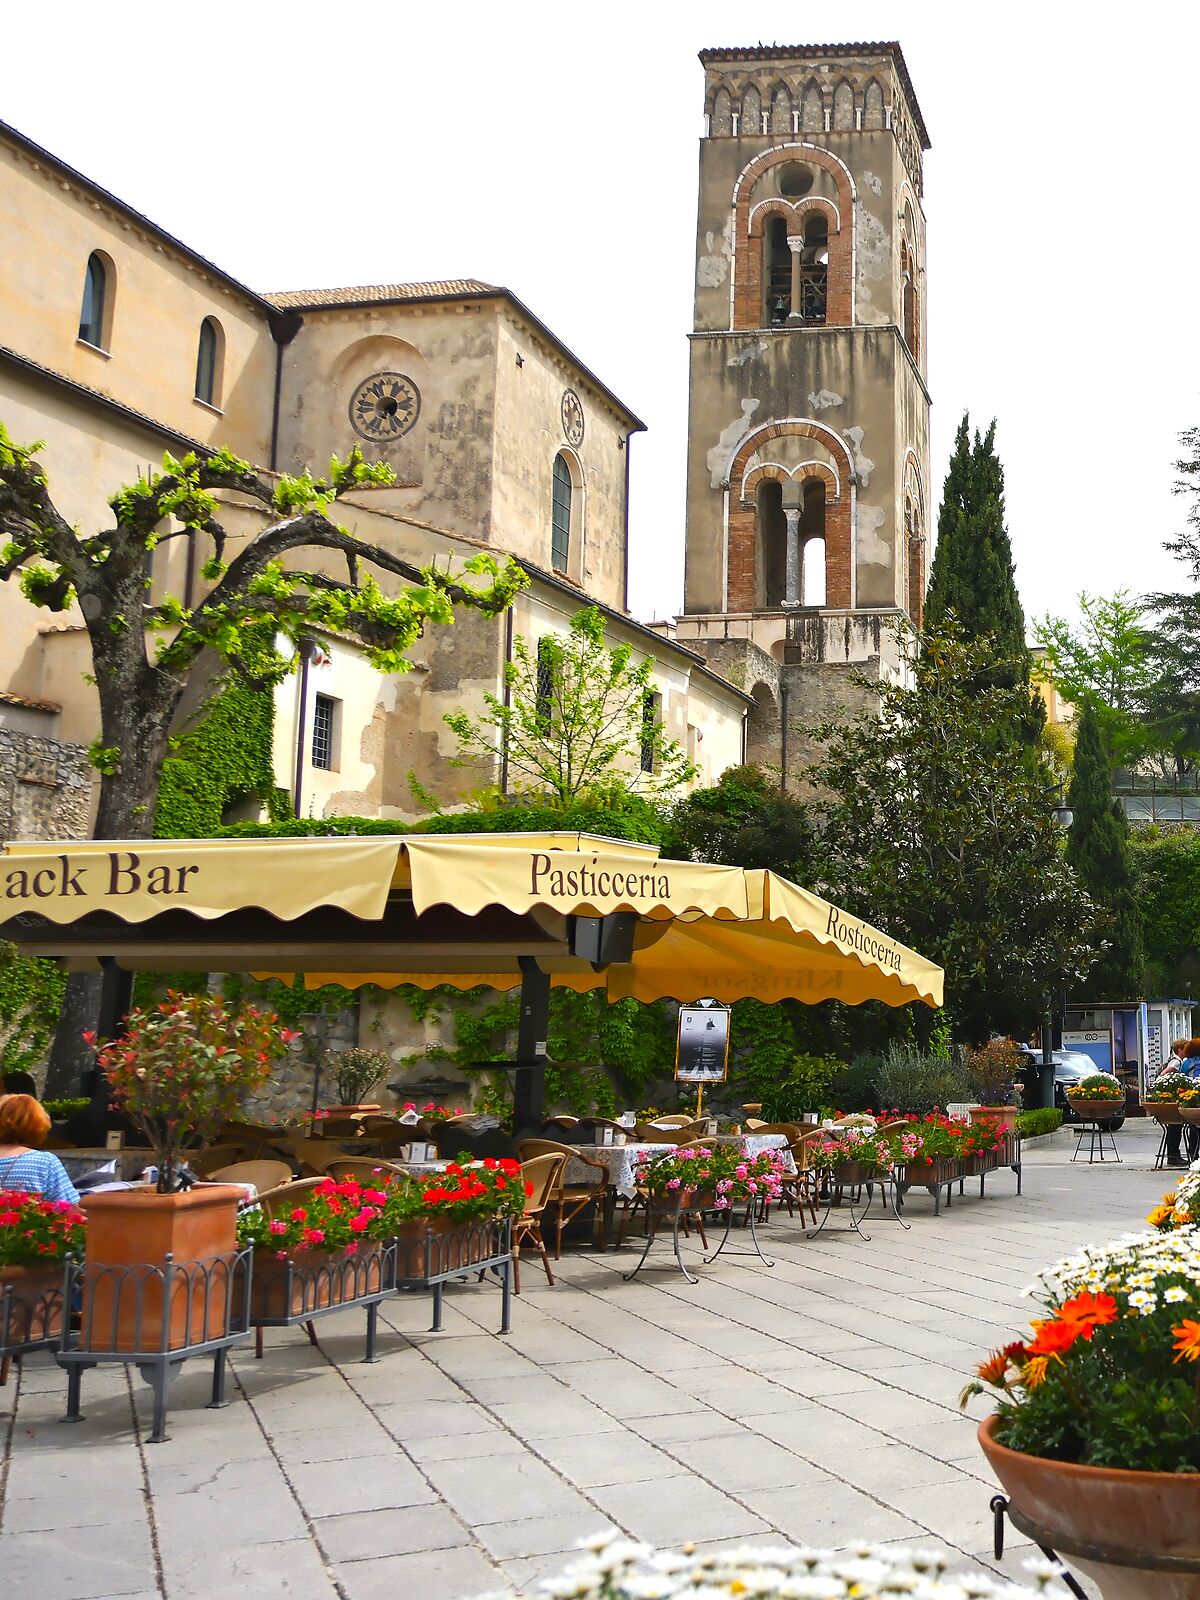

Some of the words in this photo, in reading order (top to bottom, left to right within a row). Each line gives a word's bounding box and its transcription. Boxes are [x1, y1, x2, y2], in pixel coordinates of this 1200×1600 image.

[0, 855, 88, 899] ack
[104, 852, 199, 896] Bar
[529, 853, 671, 898] Pasticceria
[825, 906, 902, 973] Rosticceria
